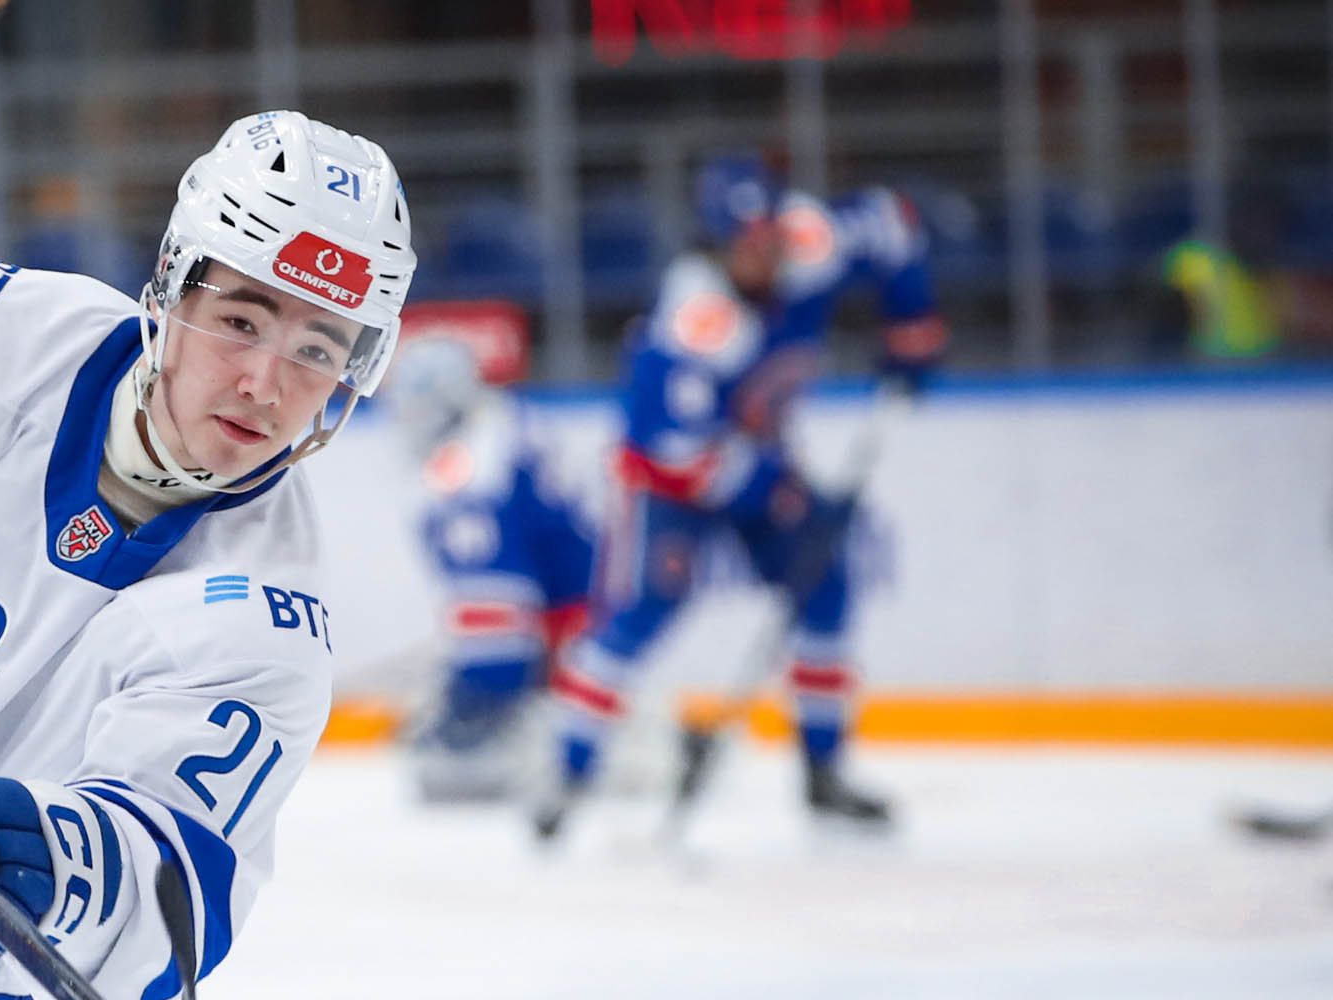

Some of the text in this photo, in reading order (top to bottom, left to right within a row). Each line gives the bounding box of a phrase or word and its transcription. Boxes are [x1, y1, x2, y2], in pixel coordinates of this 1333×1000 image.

[327, 165, 360, 201] 21
[278, 261, 362, 305] OLIMPBET
[175, 699, 283, 840] 21
[46, 804, 93, 945] CC
